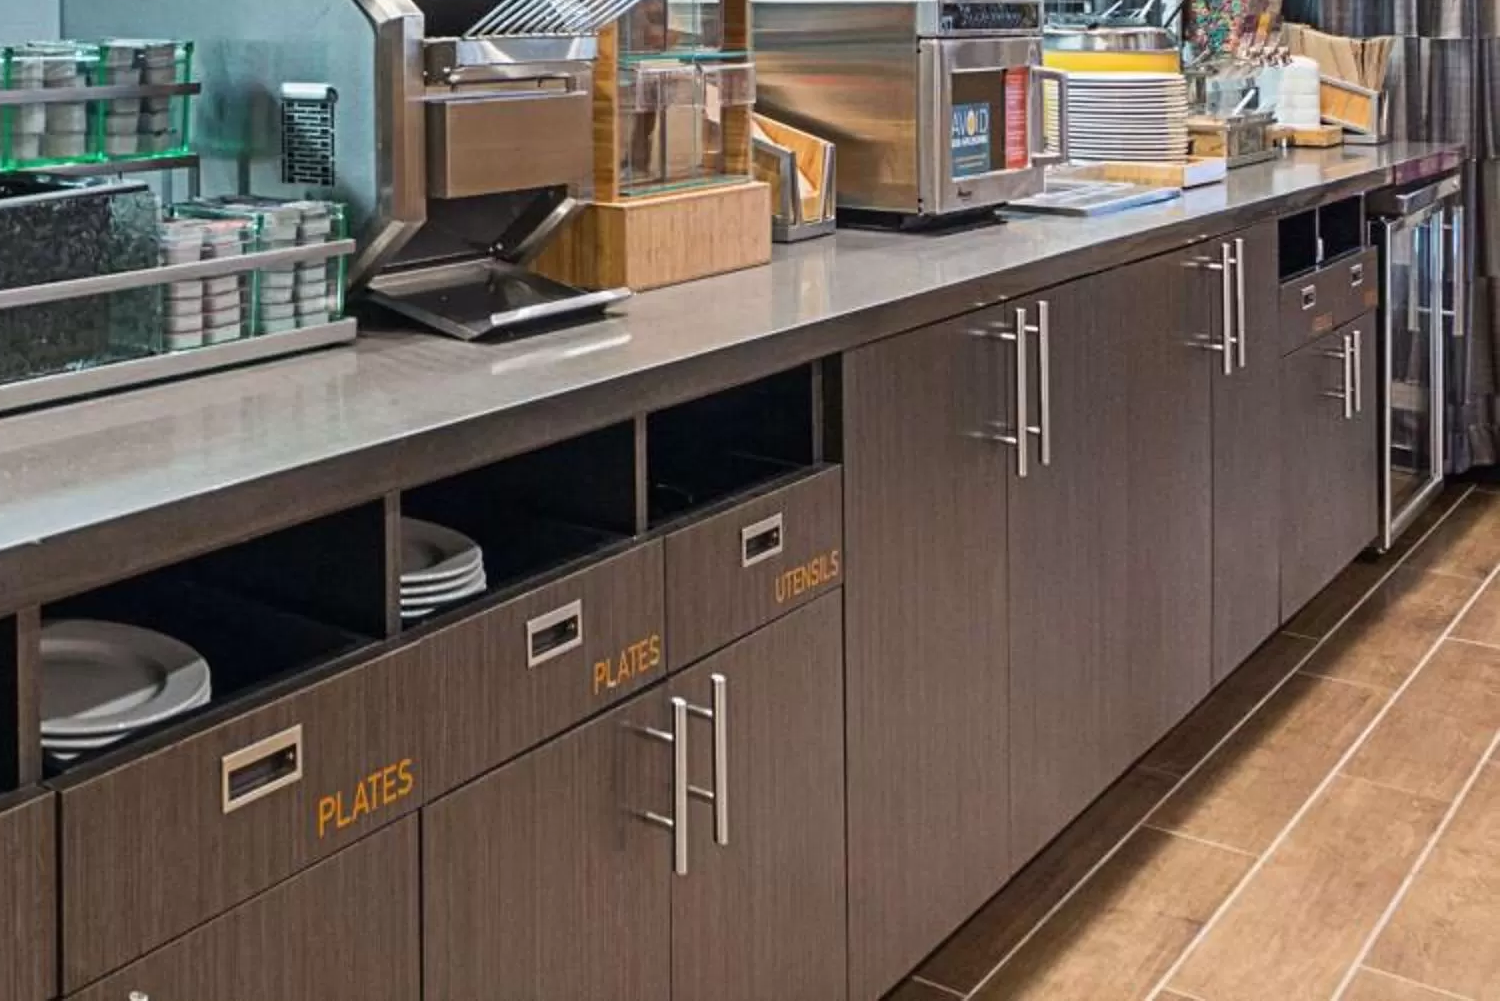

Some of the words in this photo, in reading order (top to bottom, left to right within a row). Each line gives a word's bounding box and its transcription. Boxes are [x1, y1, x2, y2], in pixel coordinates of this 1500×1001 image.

[773, 550, 840, 603] UTENSILS
[593, 634, 661, 694] PLATES
[317, 758, 414, 839] PLATES
